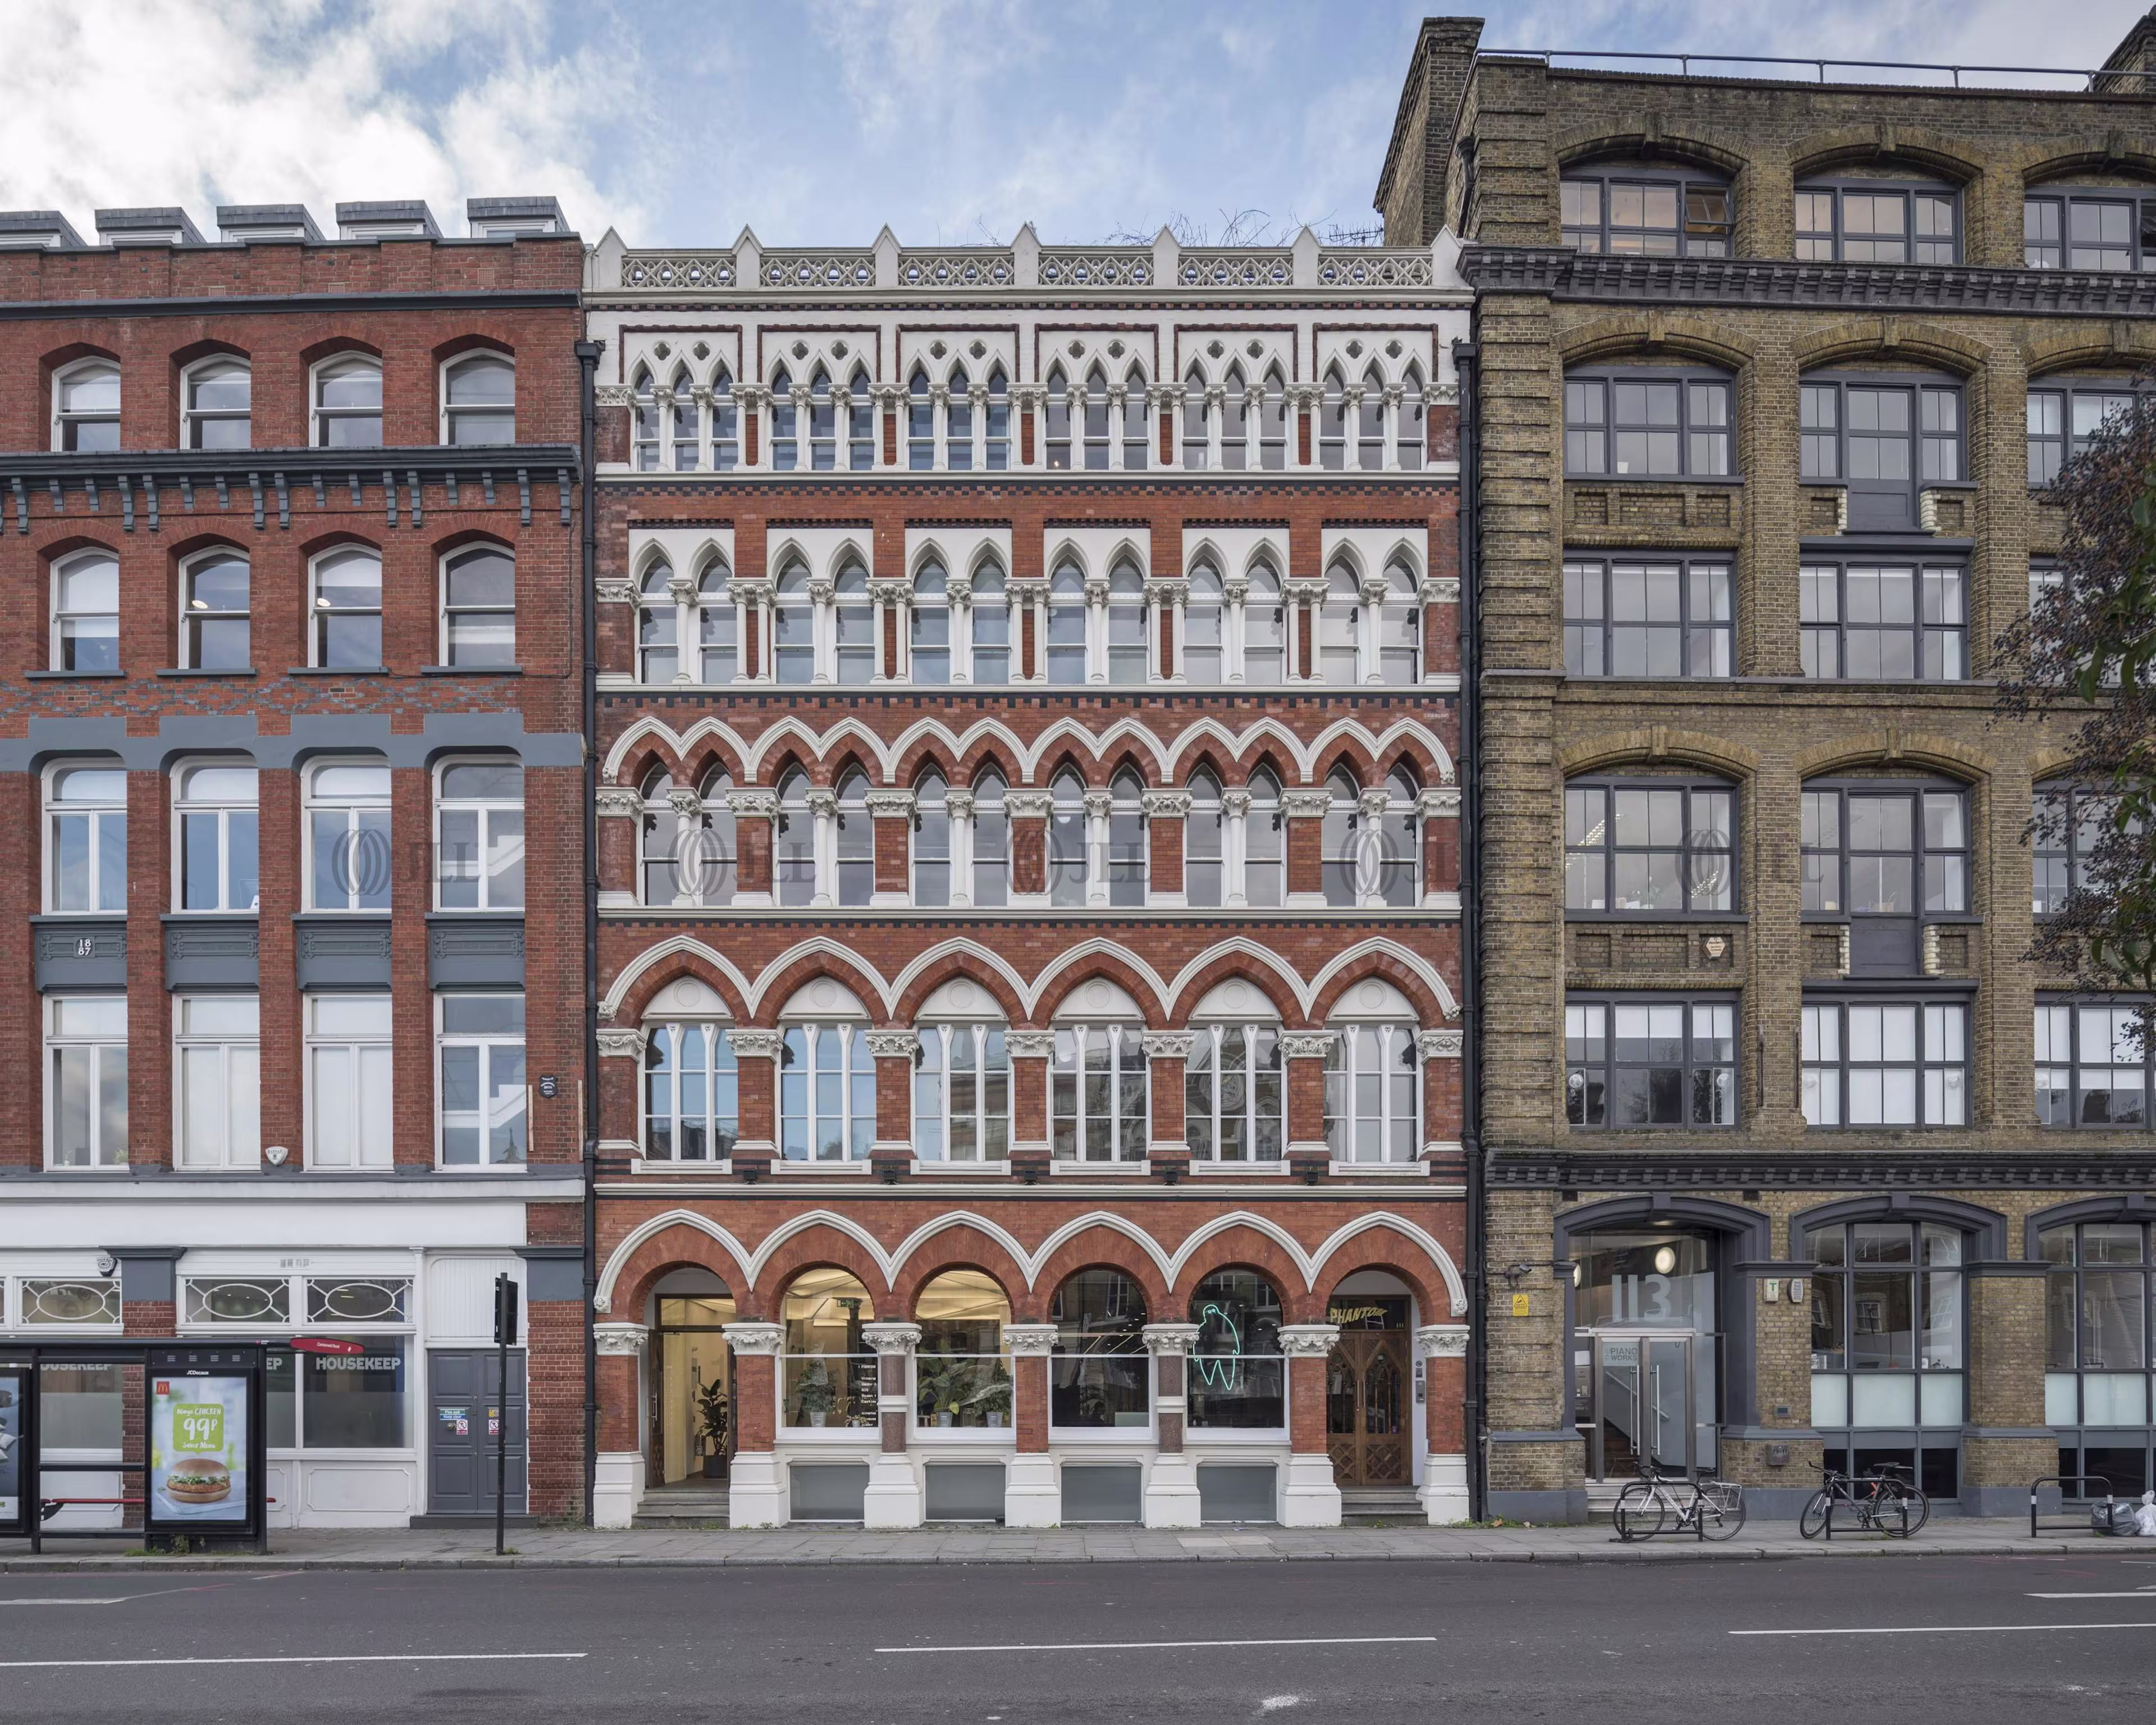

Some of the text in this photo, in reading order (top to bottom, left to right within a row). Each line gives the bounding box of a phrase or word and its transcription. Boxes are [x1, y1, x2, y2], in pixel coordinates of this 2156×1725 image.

[80, 939, 91, 947] 18
[78, 947, 91, 956] 87
[1770, 1283, 1776, 1291] T
[1612, 1274, 1671, 1322] 113
[316, 1357, 400, 1370] HOUSEKEEP
